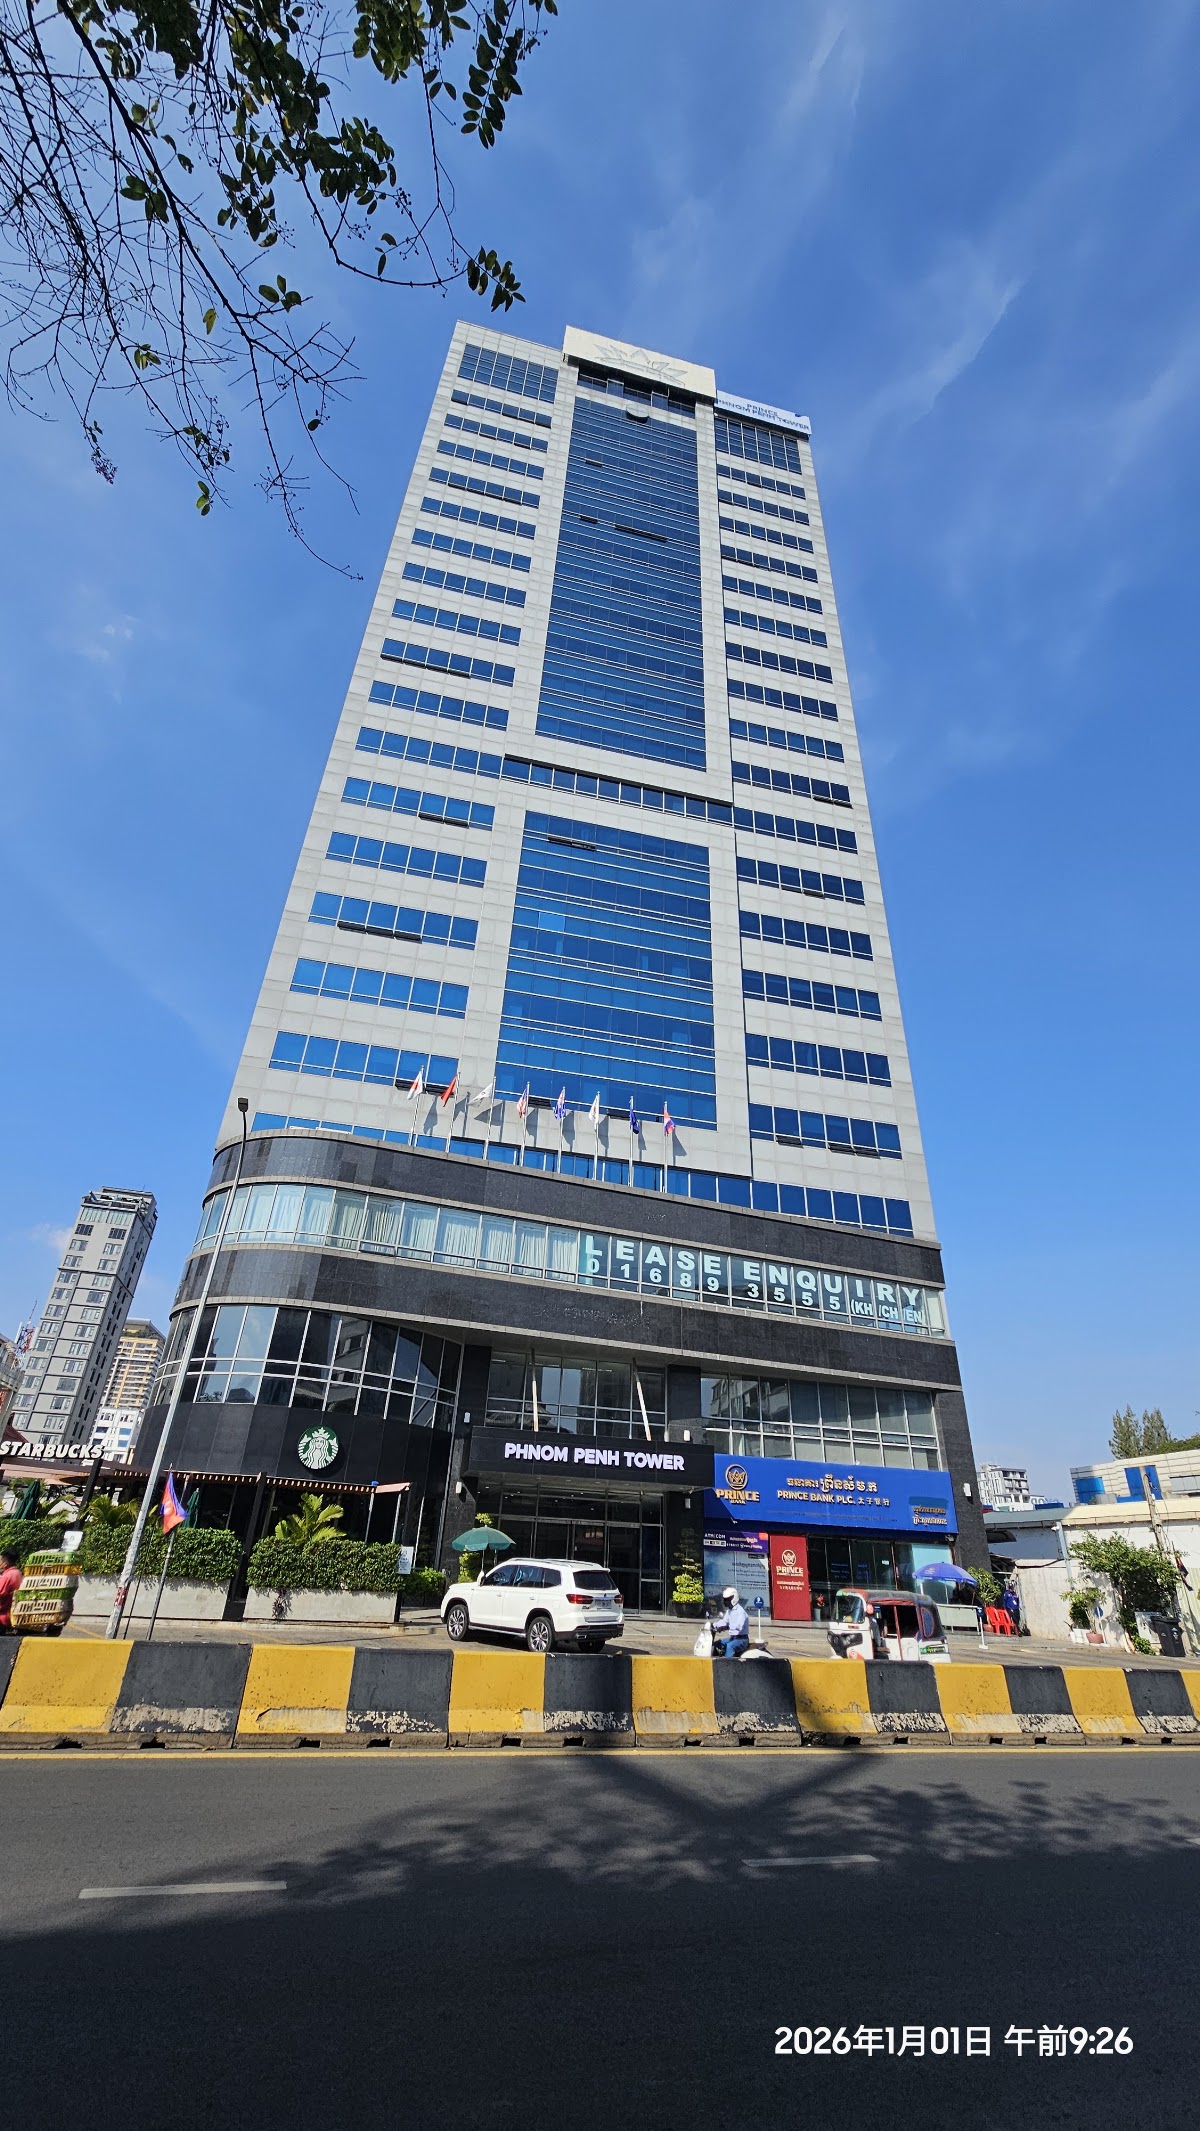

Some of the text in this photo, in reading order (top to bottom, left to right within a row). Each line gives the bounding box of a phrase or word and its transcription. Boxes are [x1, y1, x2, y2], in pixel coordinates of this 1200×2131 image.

[747, 403, 778, 417] PRINCE
[777, 416, 810, 430] TOWER
[585, 1235, 920, 1306] LEASE ENQUIRY
[0, 1441, 103, 1459] STARBUCKS
[504, 1443, 685, 1471] PHNOM PENH TOWER
[715, 1488, 760, 1502] PRINCE
[777, 1490, 809, 1500] PRINCE
[810, 1492, 835, 1503] BANK
[836, 1494, 856, 1505] PLC.
[776, 1565, 804, 1574] PRINCE
